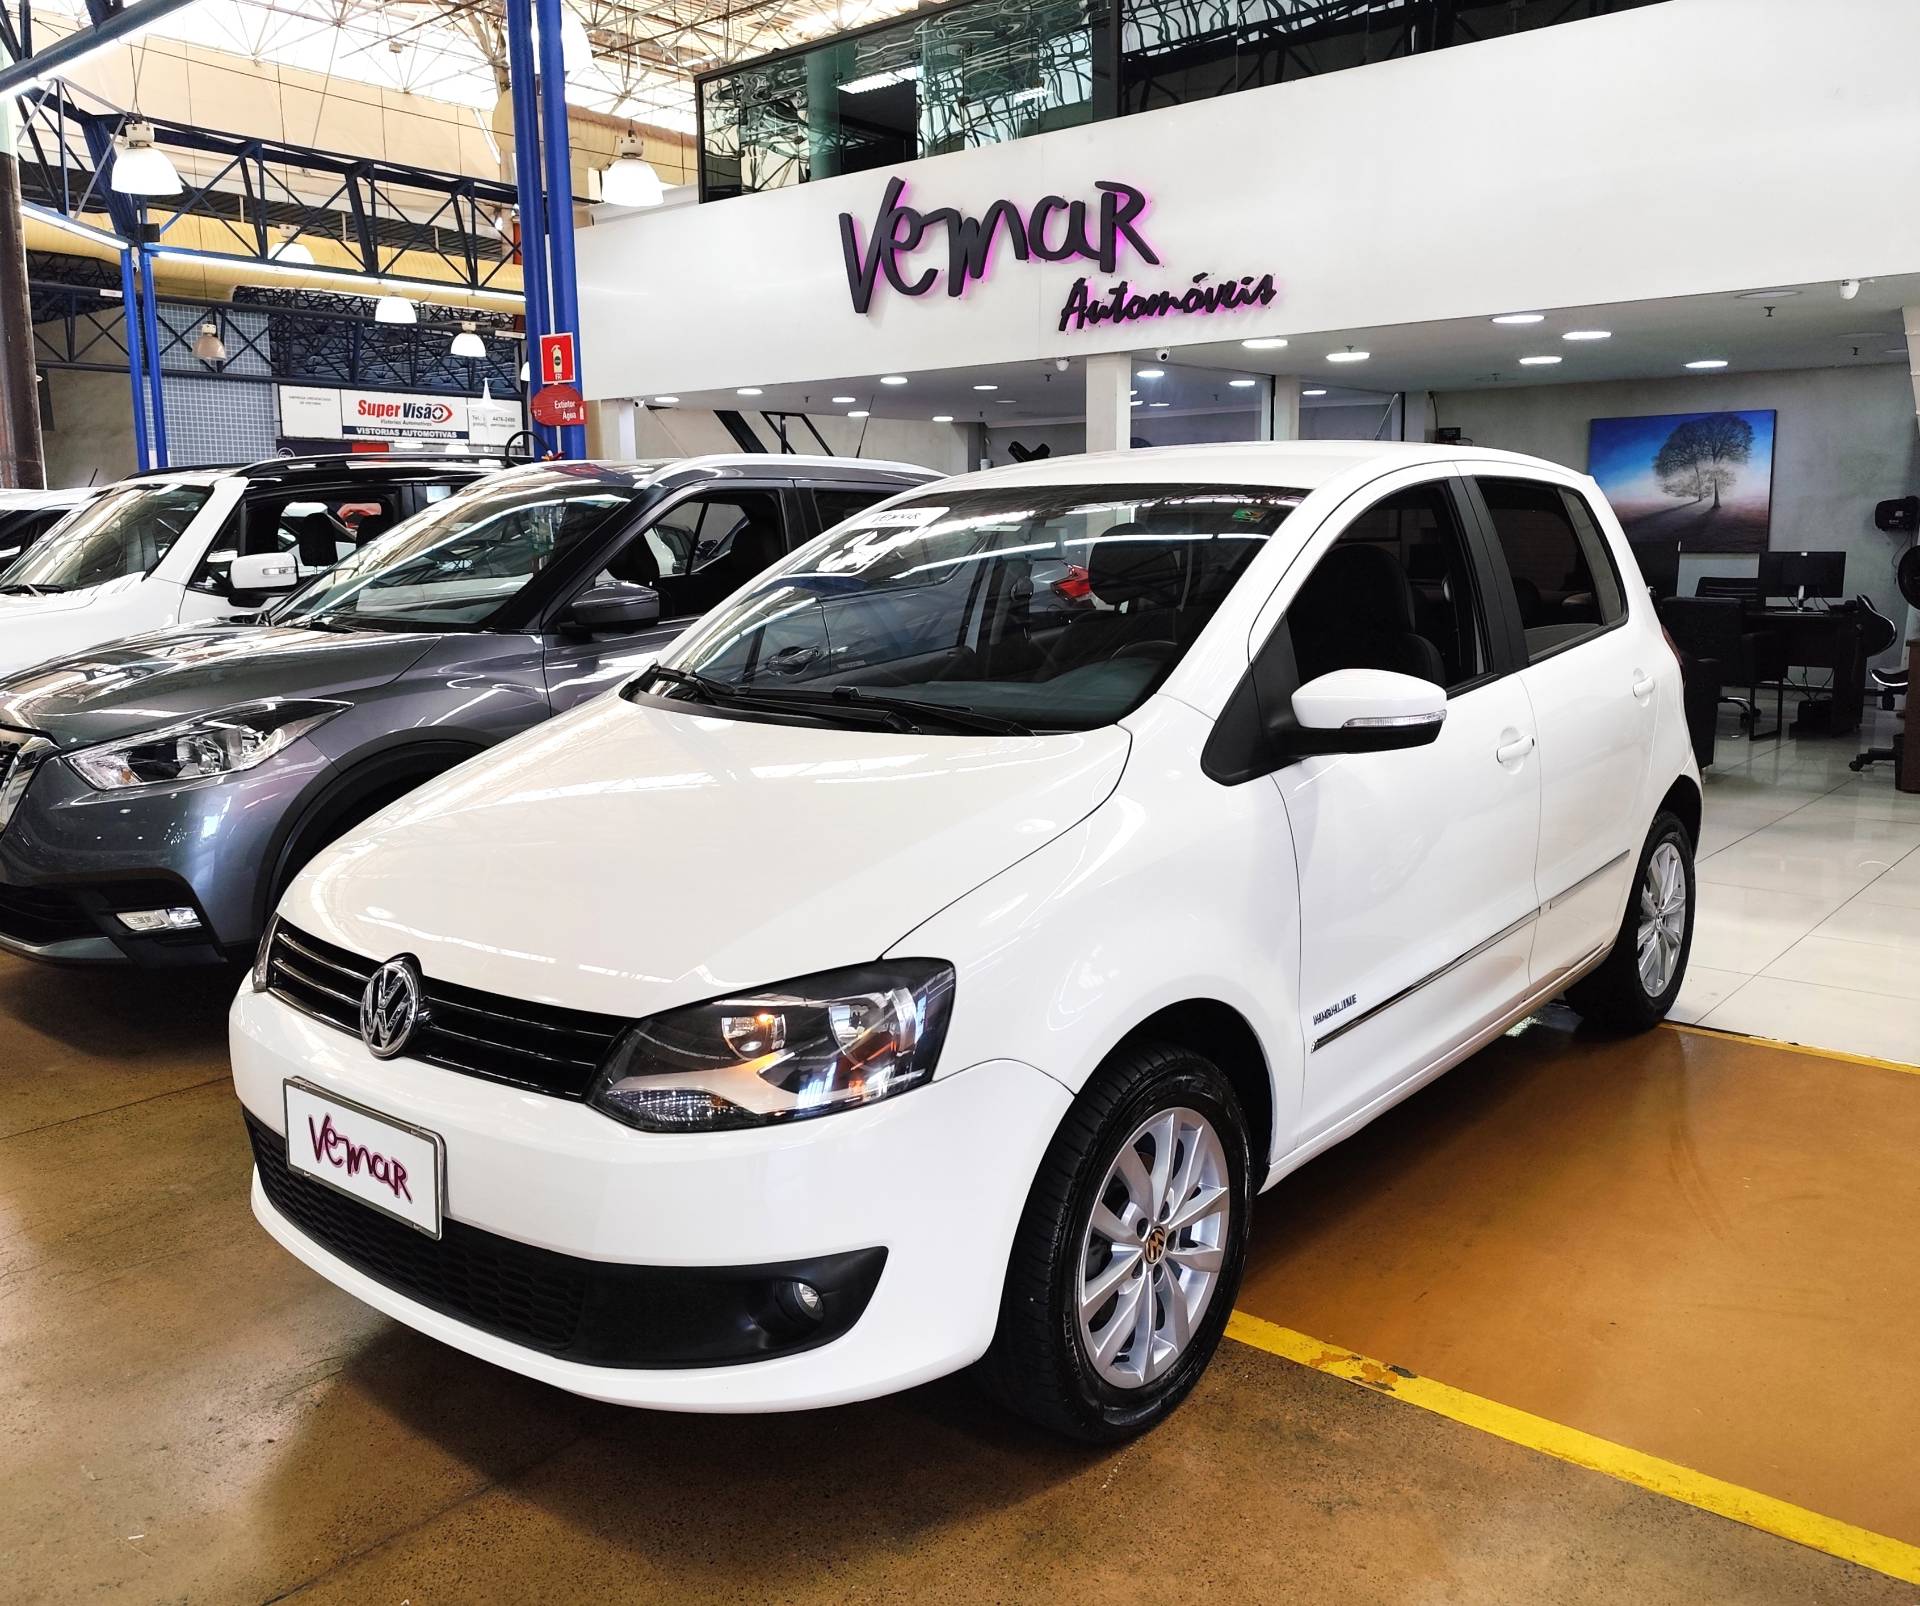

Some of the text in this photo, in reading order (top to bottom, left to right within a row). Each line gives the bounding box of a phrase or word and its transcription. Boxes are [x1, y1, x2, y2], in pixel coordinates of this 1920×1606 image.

[1058, 272, 1277, 331] Automóveis
[358, 399, 444, 420] Super Visão
[554, 400, 575, 410] Extintor
[356, 427, 457, 438] VISTORIAS AUTOMOTIVAS
[1312, 993, 1358, 1026] HIGHLINE
